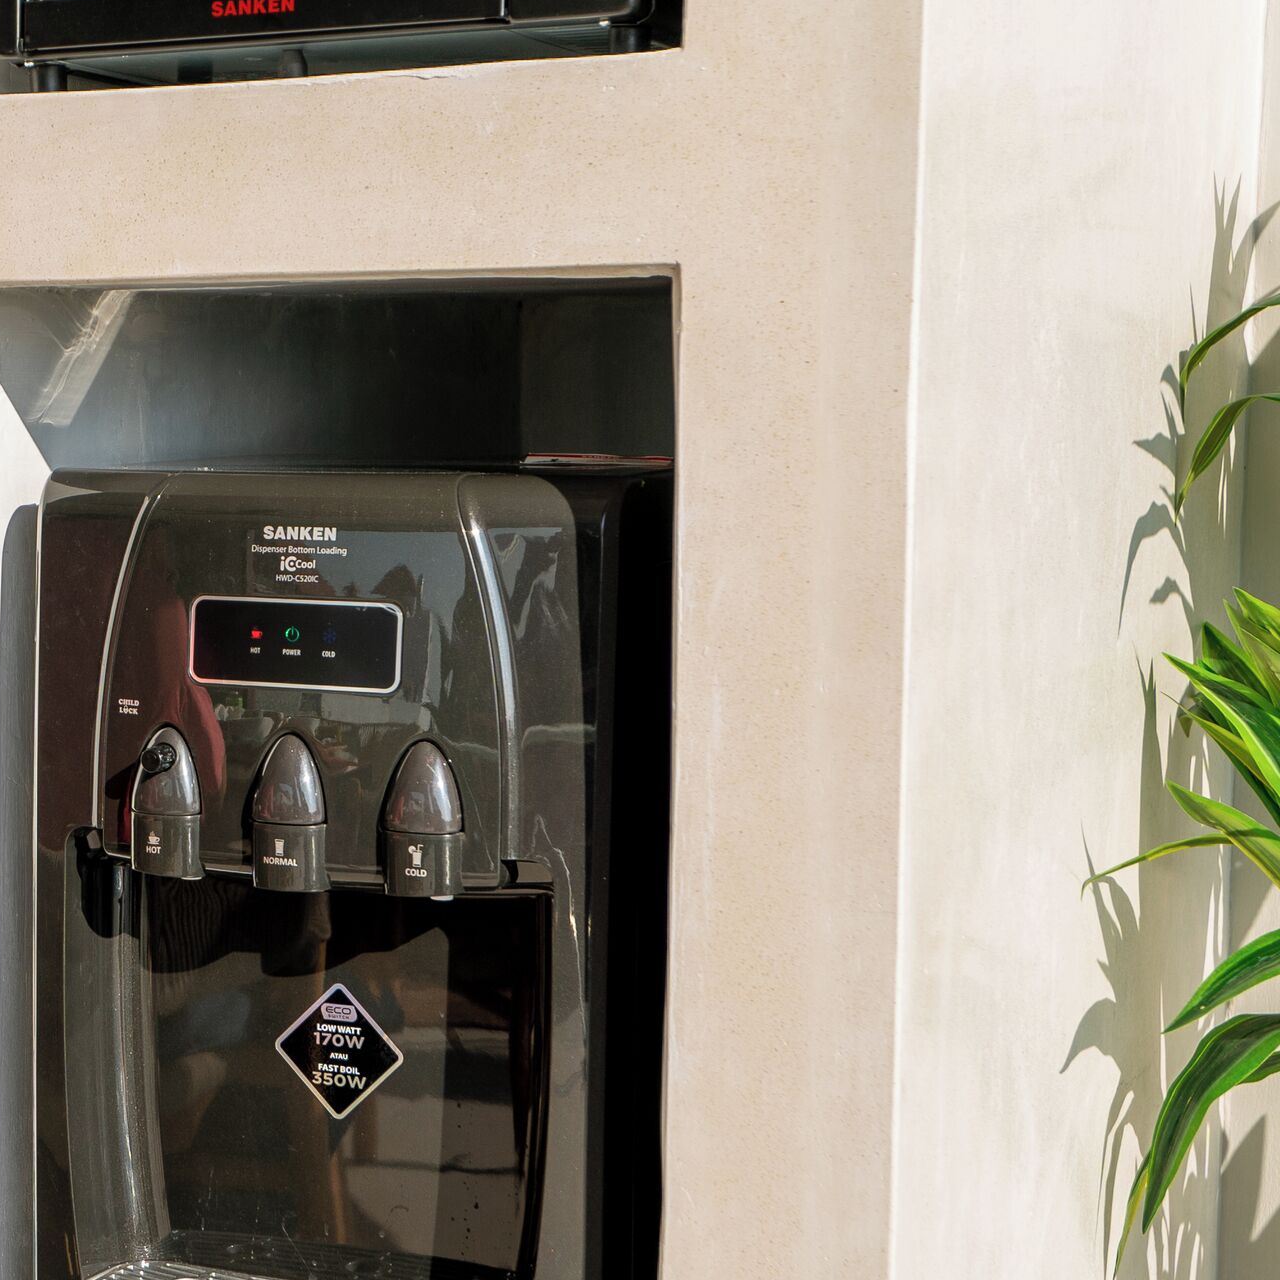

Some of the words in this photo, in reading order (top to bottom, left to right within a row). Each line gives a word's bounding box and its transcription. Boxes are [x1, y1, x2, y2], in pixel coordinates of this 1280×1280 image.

[263, 525, 337, 541] SANKEN
[251, 544, 287, 554] Dispenser
[288, 545, 315, 554] Bottom
[316, 546, 348, 557] Loading
[276, 574, 319, 583] HWD-C520IC
[282, 648, 301, 656] POWER
[322, 650, 336, 658] COLD
[118, 698, 140, 707] CHILD
[145, 845, 161, 855] HOT
[263, 856, 298, 867] NORMAL
[405, 868, 427, 878] COLD
[325, 1005, 352, 1016] ECO
[316, 1023, 337, 1033] LOW
[337, 1025, 362, 1035] WATT
[313, 1031, 365, 1050] 170W
[329, 1052, 349, 1061] ATAU
[318, 1063, 339, 1073] FAST
[339, 1065, 361, 1075] BOIL
[312, 1071, 367, 1090] 350W
